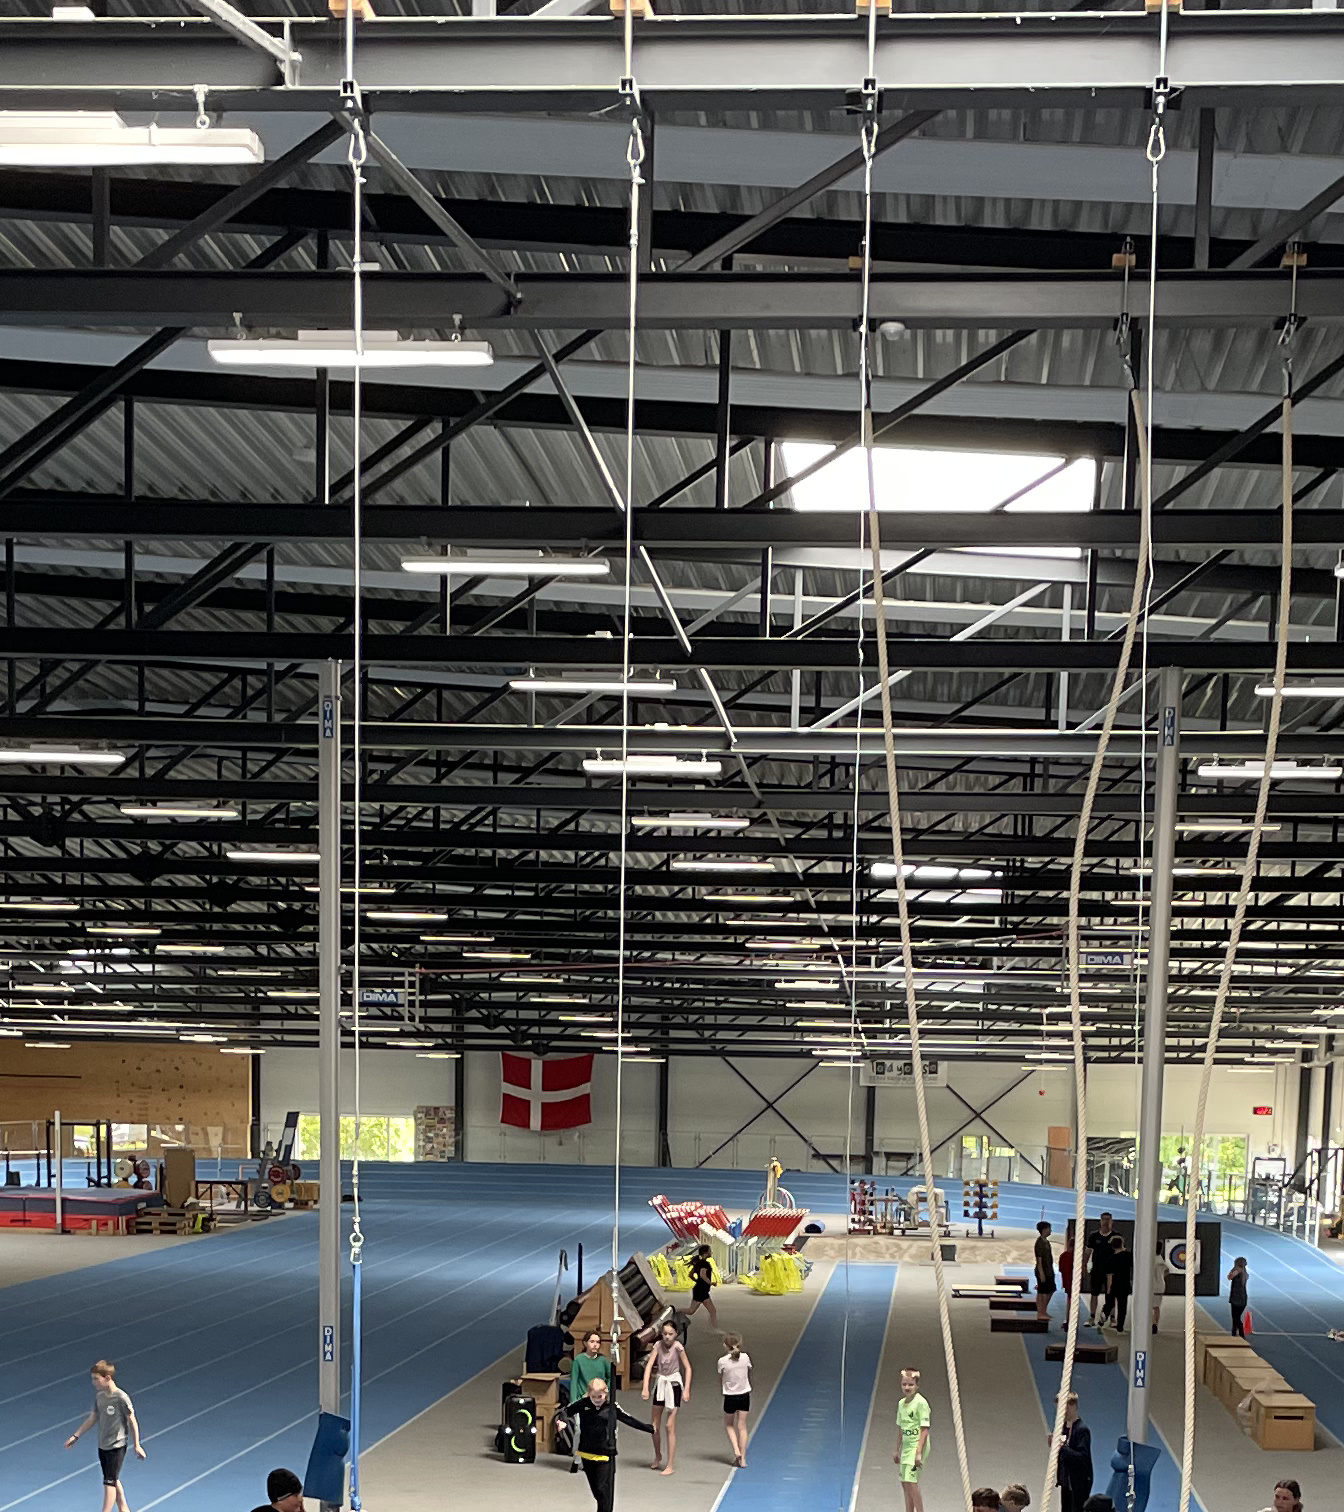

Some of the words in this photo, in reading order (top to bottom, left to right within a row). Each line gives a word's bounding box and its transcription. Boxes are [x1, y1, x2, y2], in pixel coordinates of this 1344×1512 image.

[1087, 955, 1122, 964] DIMA
[363, 992, 396, 1001] DIMA
[324, 1326, 333, 1361] DIMA
[1136, 1352, 1145, 1387] DIMA
